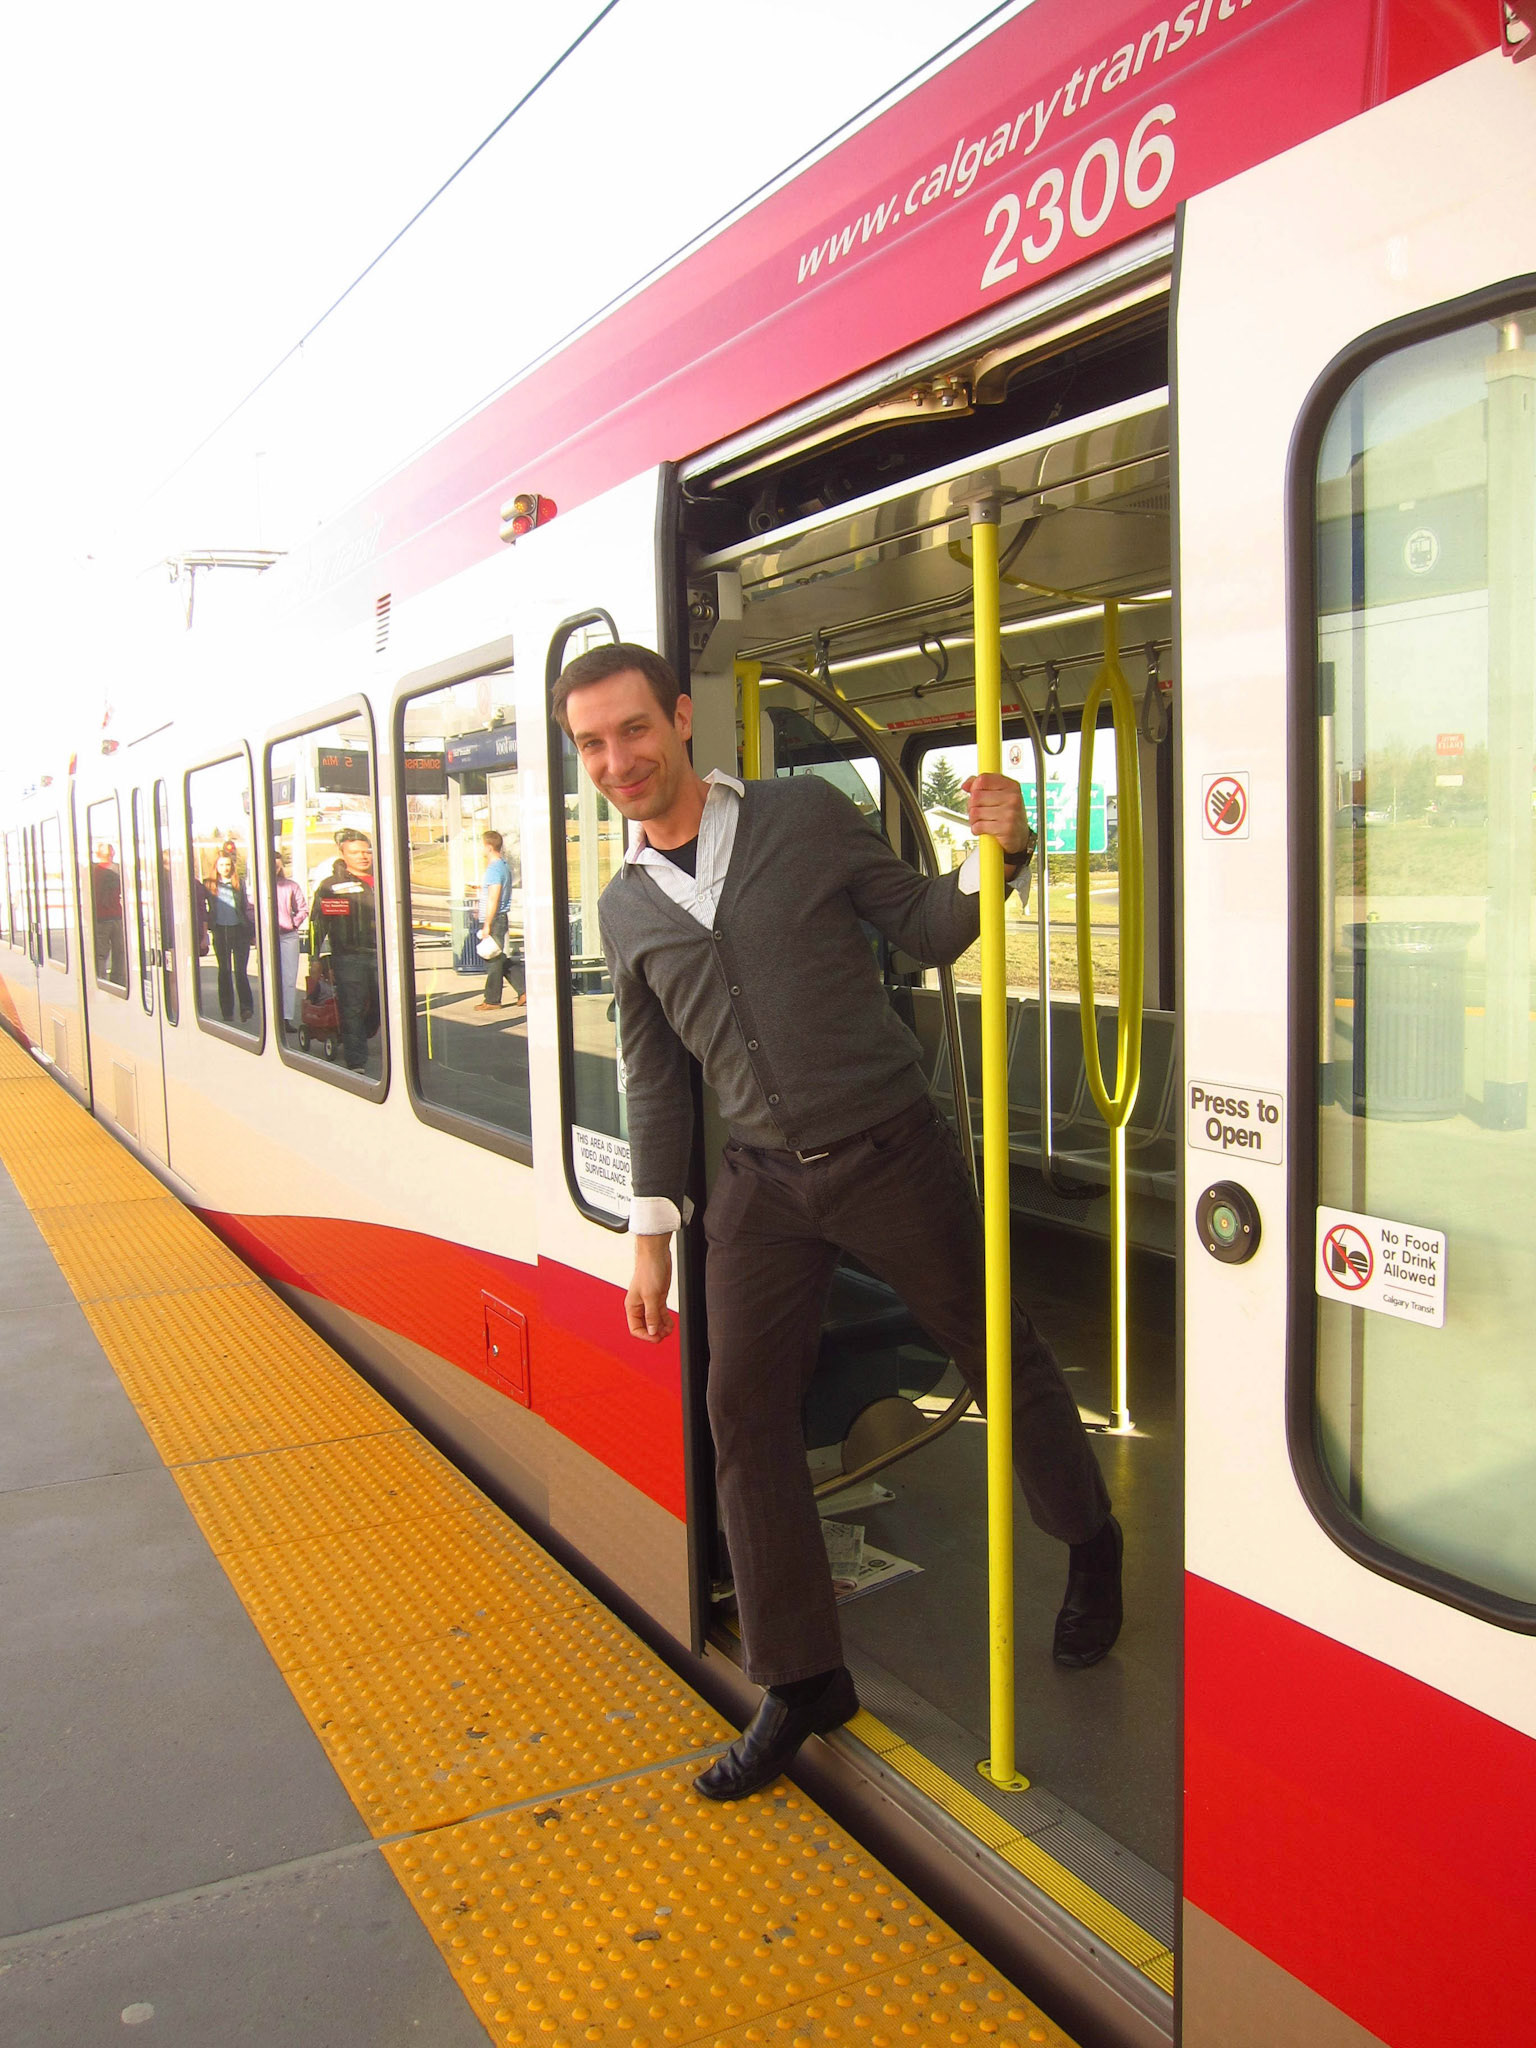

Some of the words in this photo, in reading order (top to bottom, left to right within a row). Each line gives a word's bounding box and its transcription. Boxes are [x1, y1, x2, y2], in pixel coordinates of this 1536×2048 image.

[980, 103, 1177, 290] 2306
[1191, 1087, 1250, 1119] Press
[1257, 1099, 1279, 1124] to
[576, 1132, 589, 1145] THIS
[590, 1137, 605, 1150] AREA
[606, 1142, 613, 1154] IS
[614, 1145, 631, 1160] UNDE
[1205, 1117, 1262, 1150] Open
[580, 1147, 597, 1162] VIDEO
[599, 1154, 611, 1166] AND
[612, 1159, 630, 1174] AUDIO
[585, 1162, 627, 1187] SURVEILLANCE
[1381, 1229, 1399, 1245] No
[1405, 1234, 1439, 1254] Food
[1382, 1249, 1397, 1261] or
[1402, 1250, 1436, 1271] Drink
[1383, 1263, 1436, 1287] Allowed
[1382, 1294, 1410, 1310] Calgary
[1411, 1301, 1435, 1314] Transit
